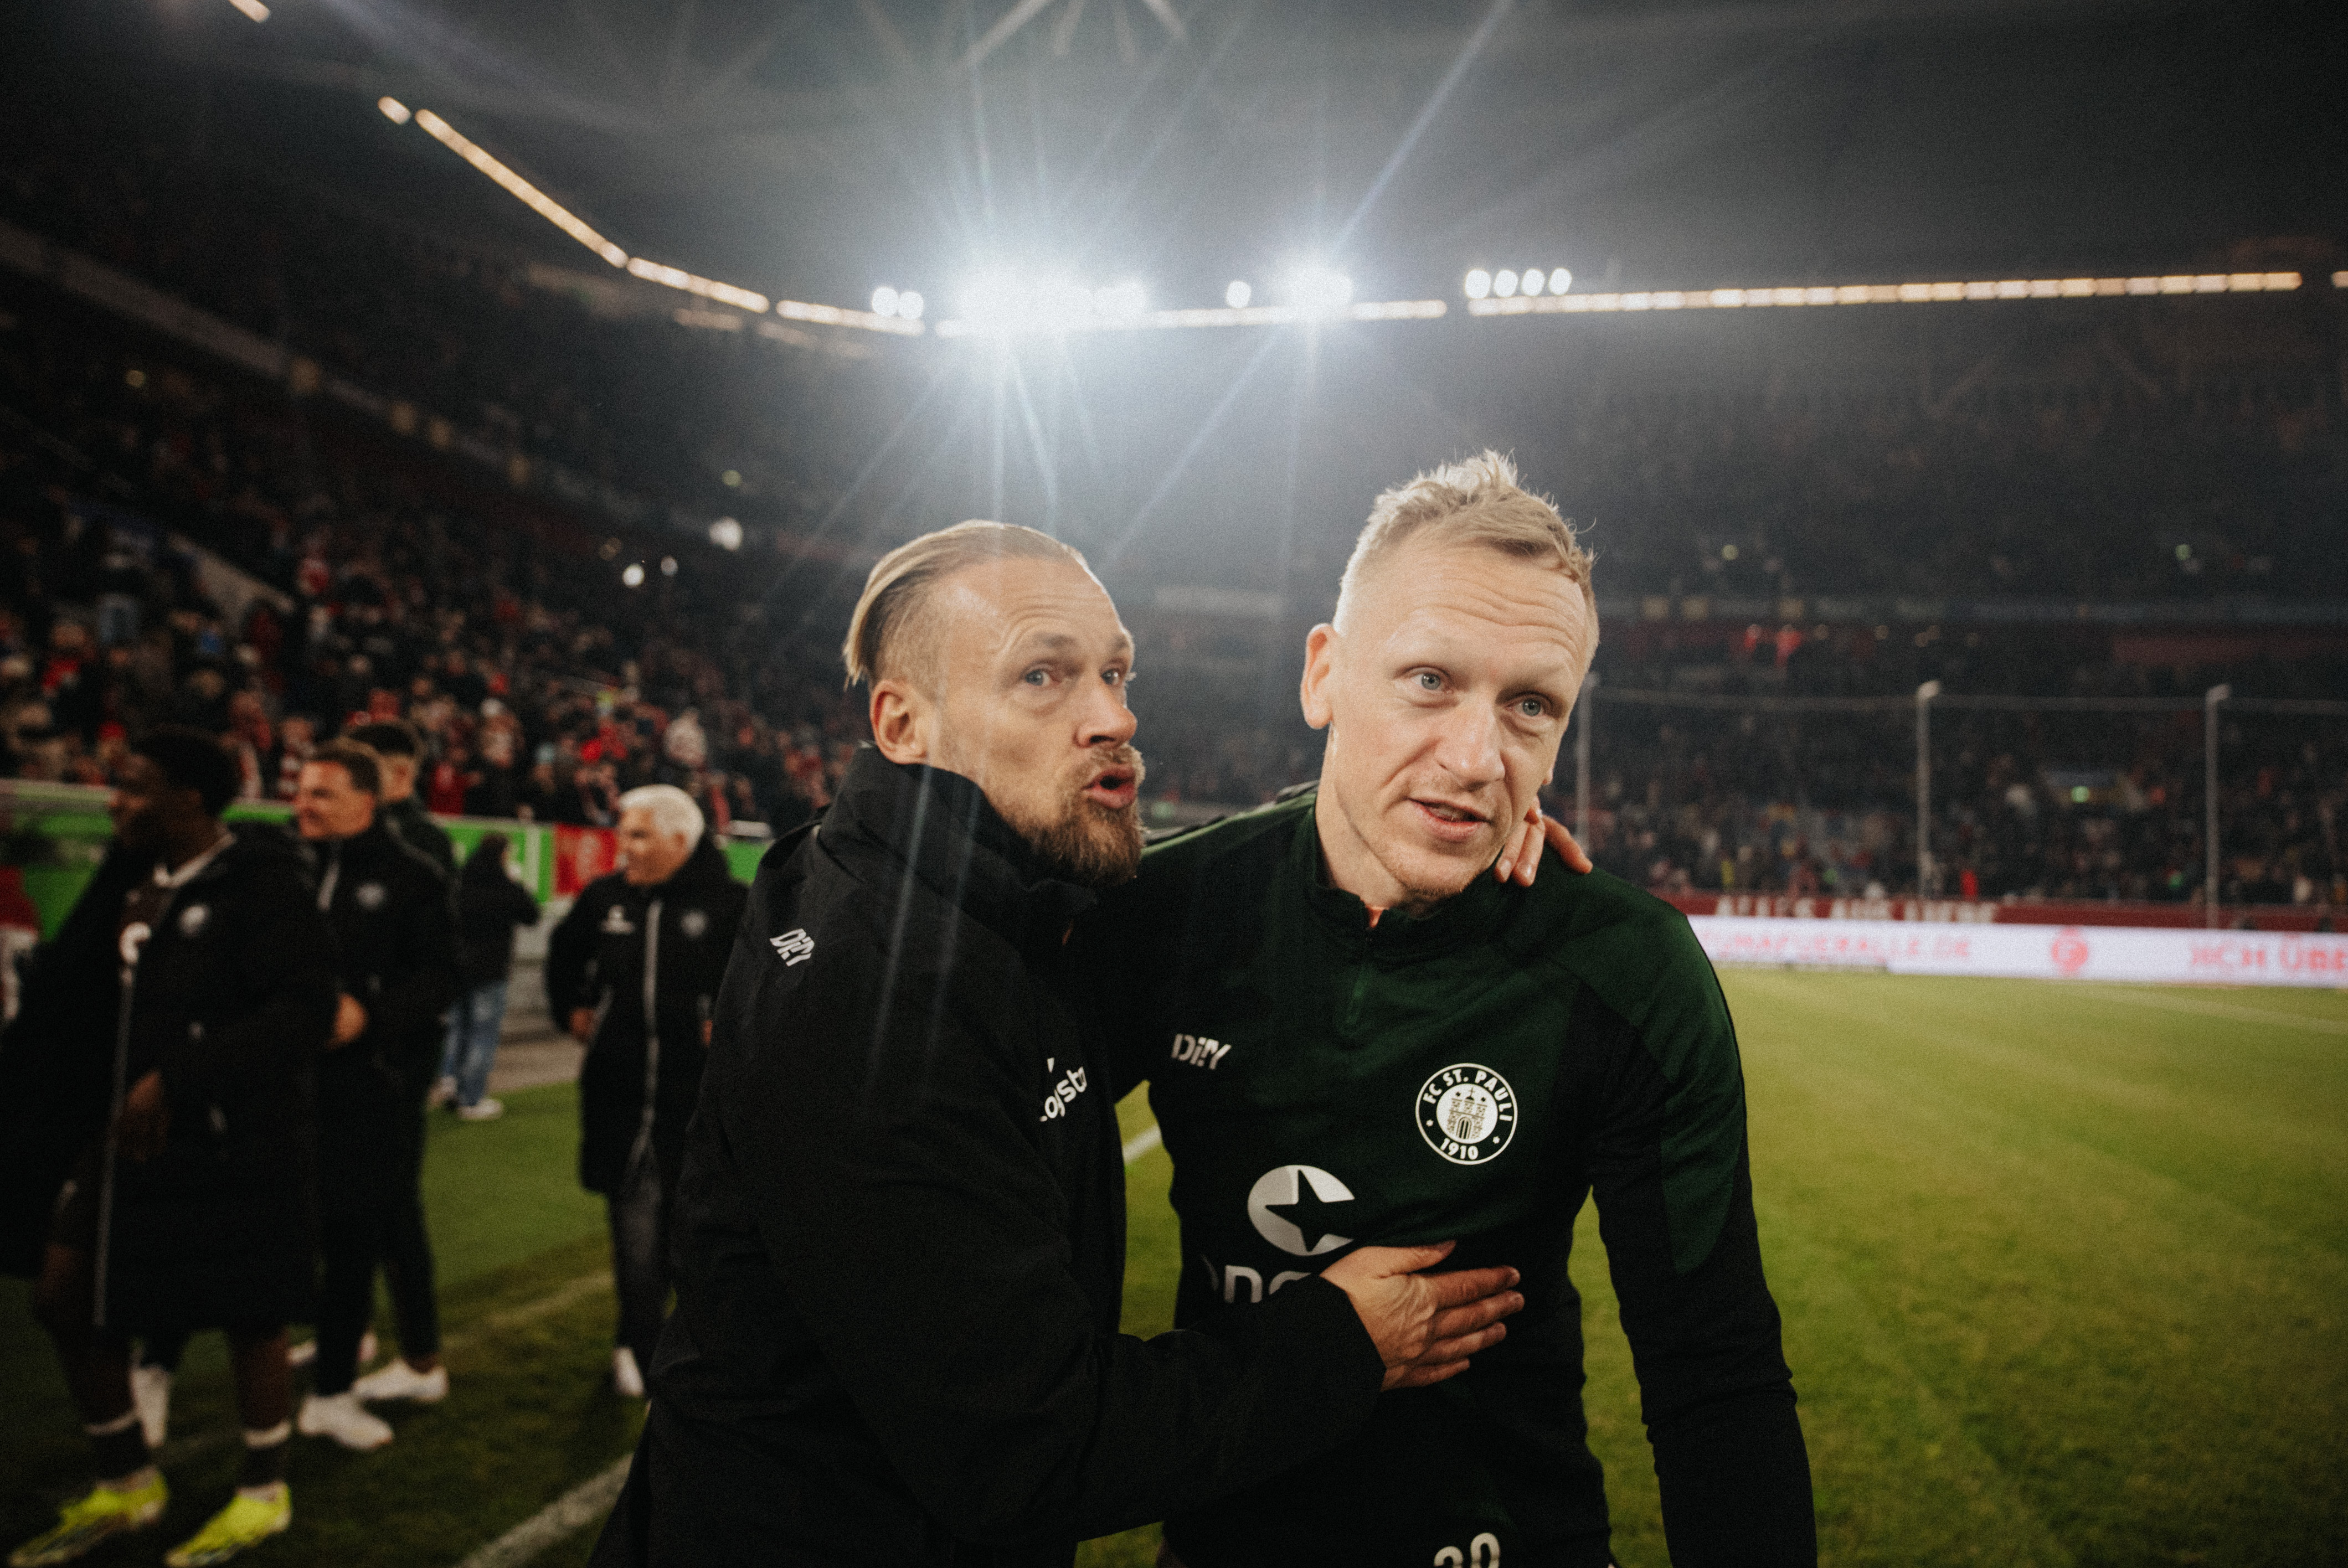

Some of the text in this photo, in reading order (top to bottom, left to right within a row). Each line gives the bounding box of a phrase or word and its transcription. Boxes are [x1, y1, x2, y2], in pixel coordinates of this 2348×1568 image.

[1422, 1069, 1513, 1122] FC ST. PAULI
[1440, 1137, 1479, 1160] 1910
